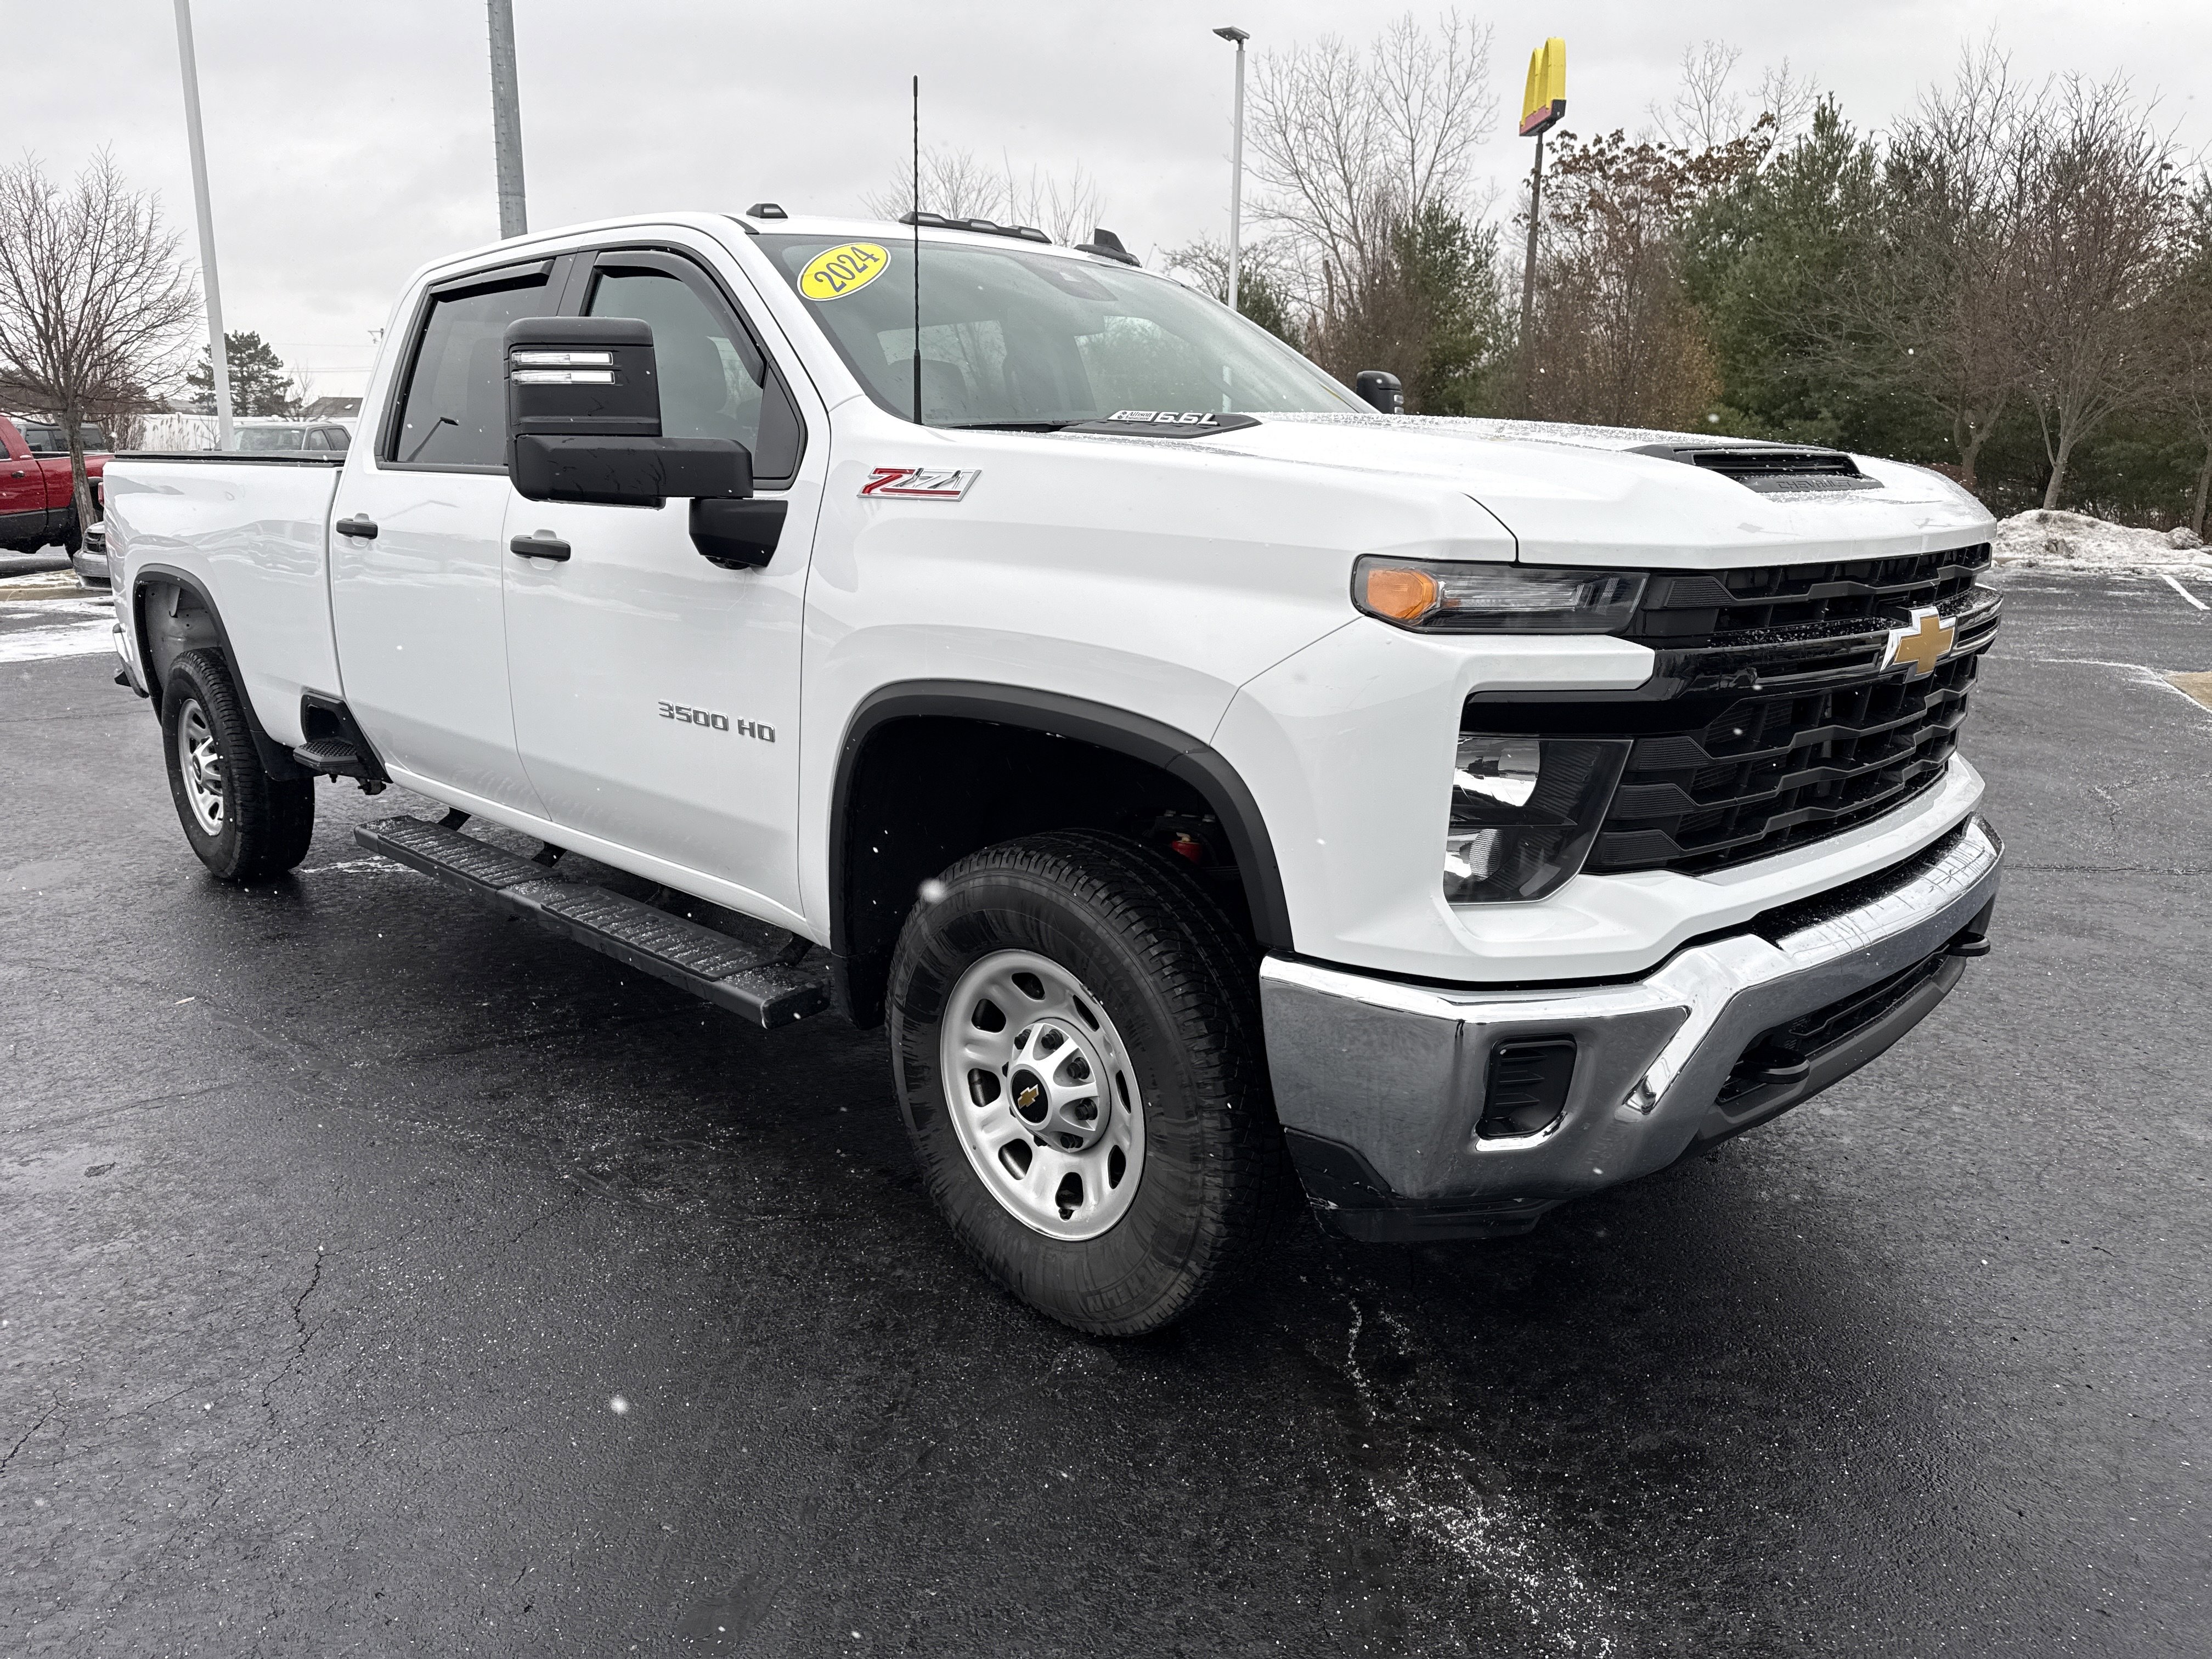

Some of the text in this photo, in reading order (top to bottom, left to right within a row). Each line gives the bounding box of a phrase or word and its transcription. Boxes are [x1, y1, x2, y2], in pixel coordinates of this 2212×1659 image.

[814, 246, 880, 293] 2024
[1153, 411, 1220, 426] 6.6L
[856, 466, 982, 501] Z71
[1776, 479, 1852, 489] CHEVROLET
[658, 700, 776, 743] 3500 HD
